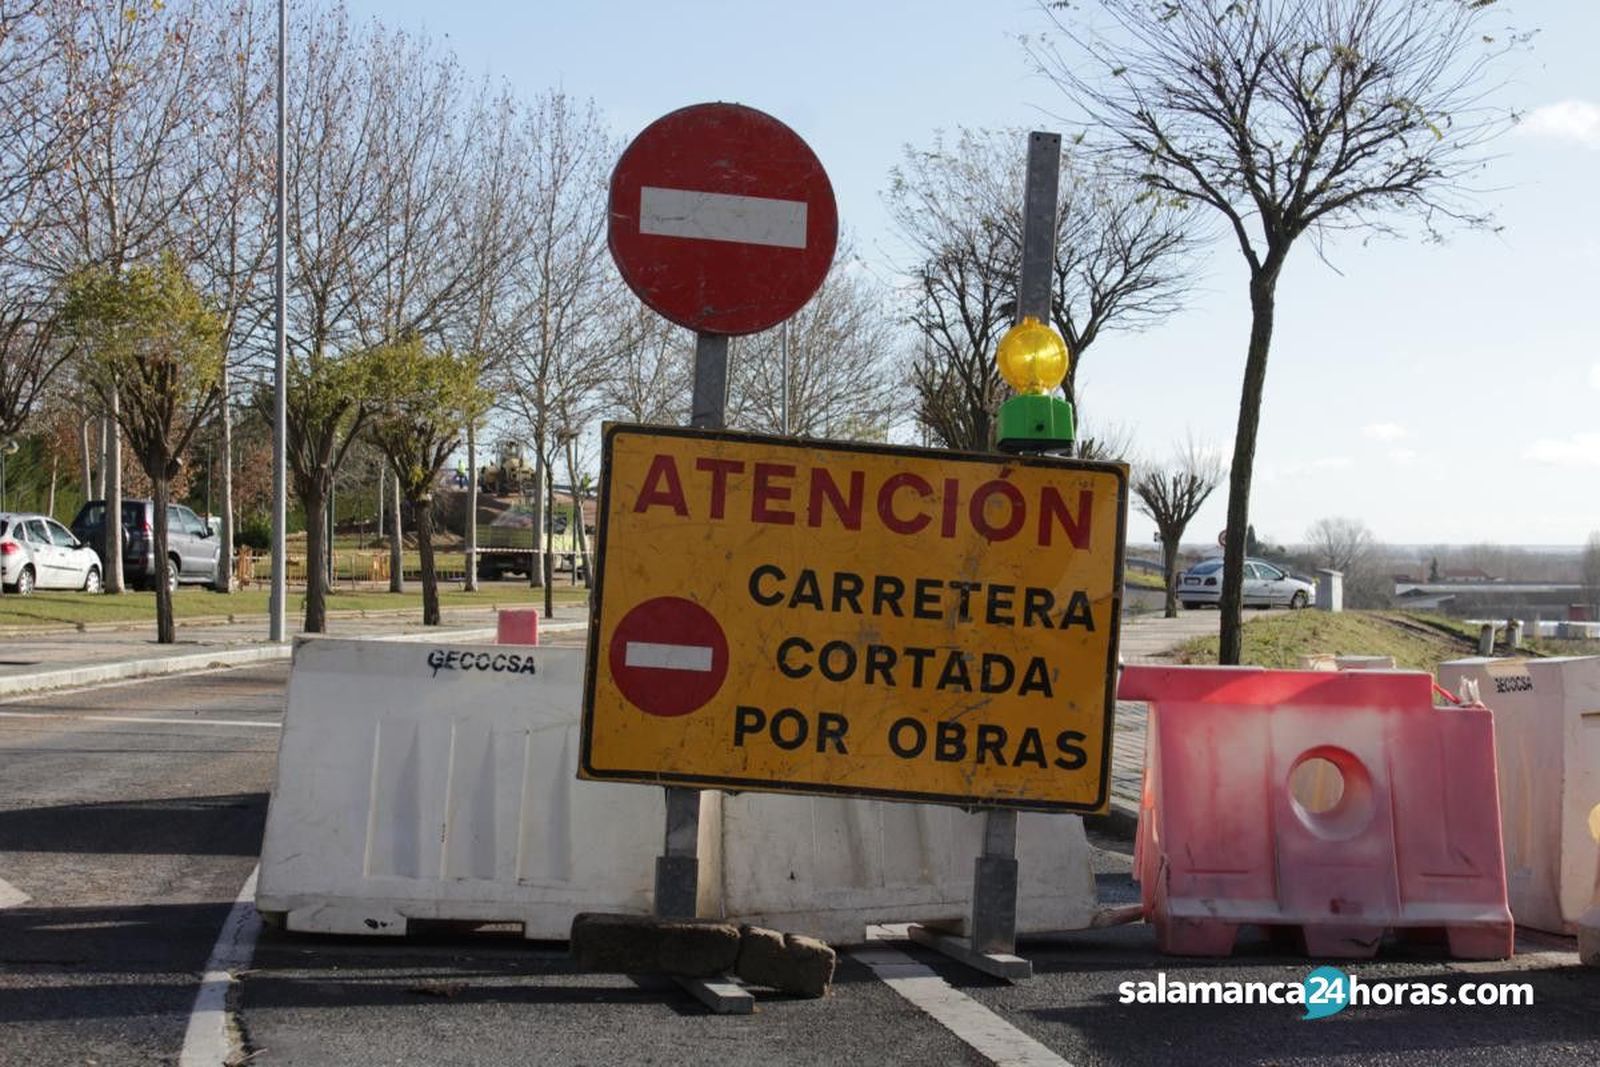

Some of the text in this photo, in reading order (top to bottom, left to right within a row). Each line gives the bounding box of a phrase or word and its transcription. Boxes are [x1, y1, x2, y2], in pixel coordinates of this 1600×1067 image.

[633, 454, 1093, 550] ATENCIÓN
[749, 564, 1095, 632] CARRETERA
[428, 649, 536, 677] GECOCSA
[777, 637, 1053, 698] CORTADA
[733, 706, 1087, 770] POR OBRAS
